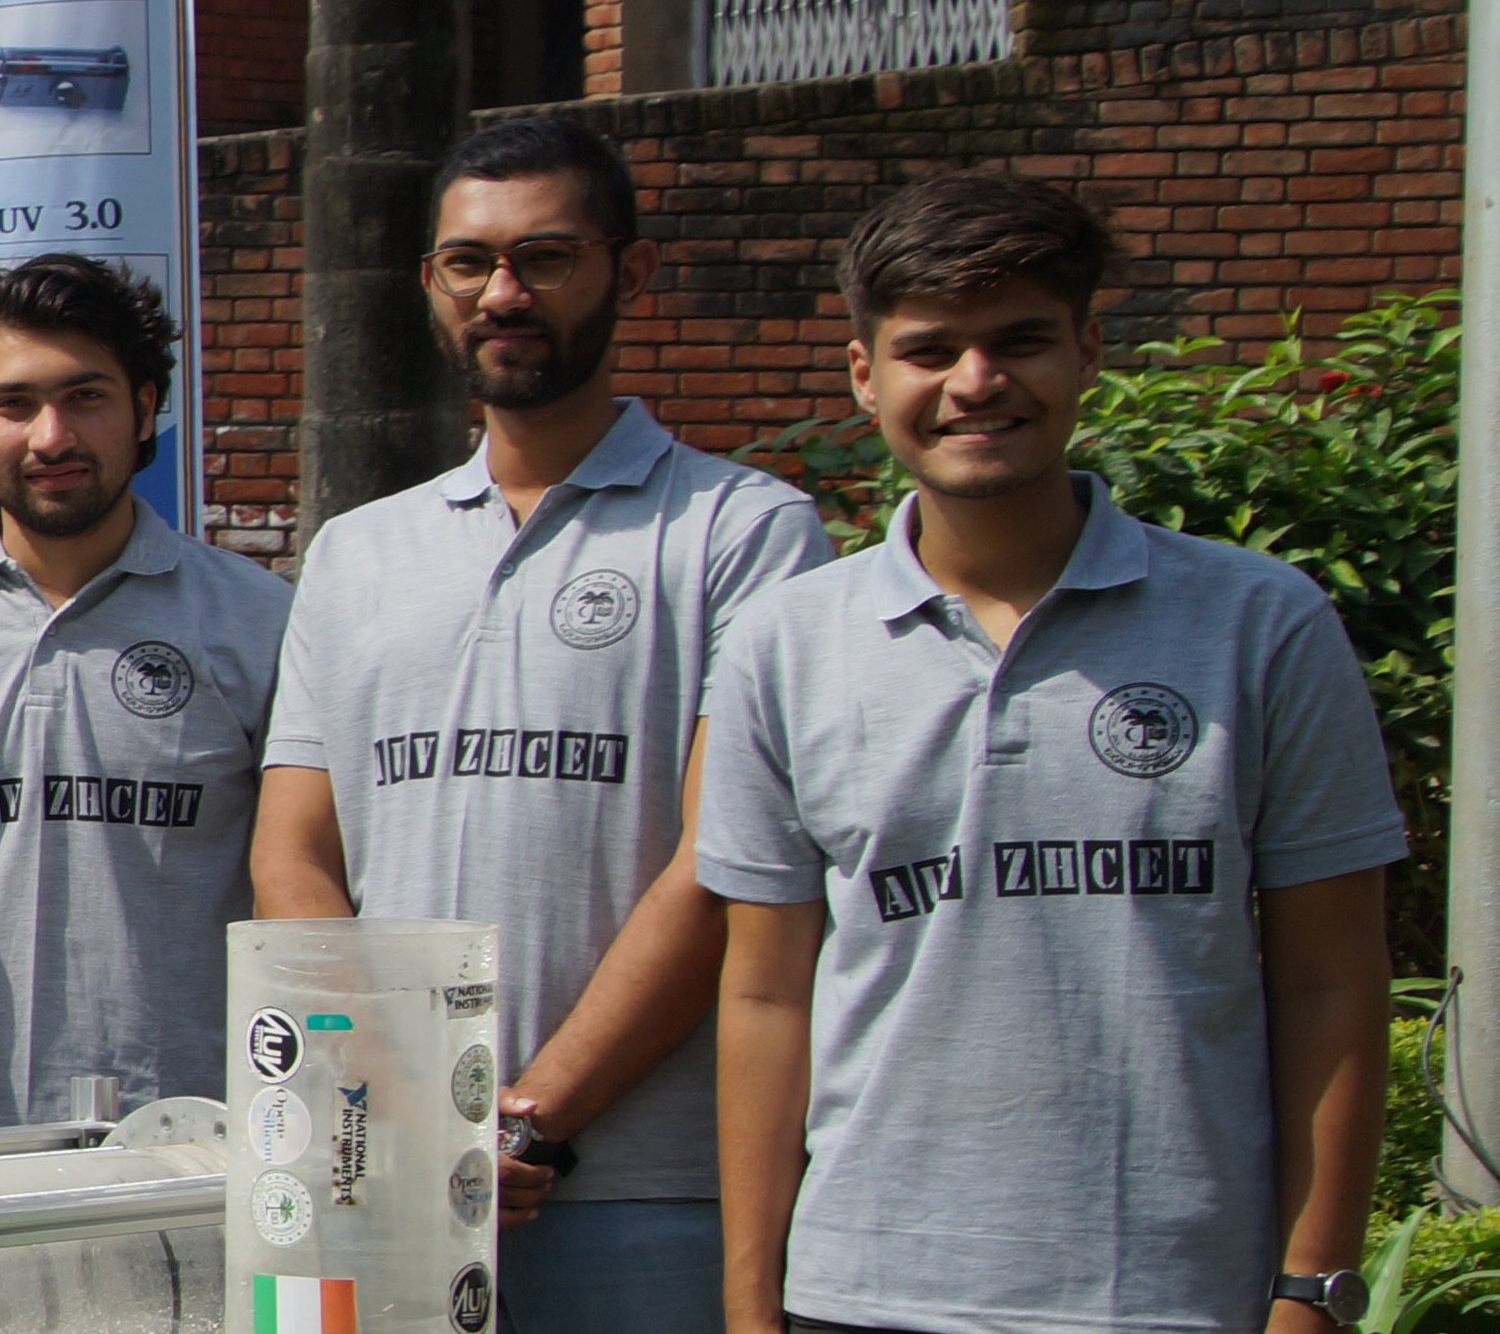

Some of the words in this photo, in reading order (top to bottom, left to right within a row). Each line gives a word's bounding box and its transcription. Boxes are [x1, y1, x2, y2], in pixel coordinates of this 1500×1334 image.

[64, 197, 124, 233] 3.0
[451, 728, 629, 785] ZHCET
[42, 774, 205, 829] ZHCET
[993, 838, 1216, 898] ZHCET
[340, 1107, 354, 1204] INSTRUMENTS
[354, 1112, 368, 1180] NATIONAL
